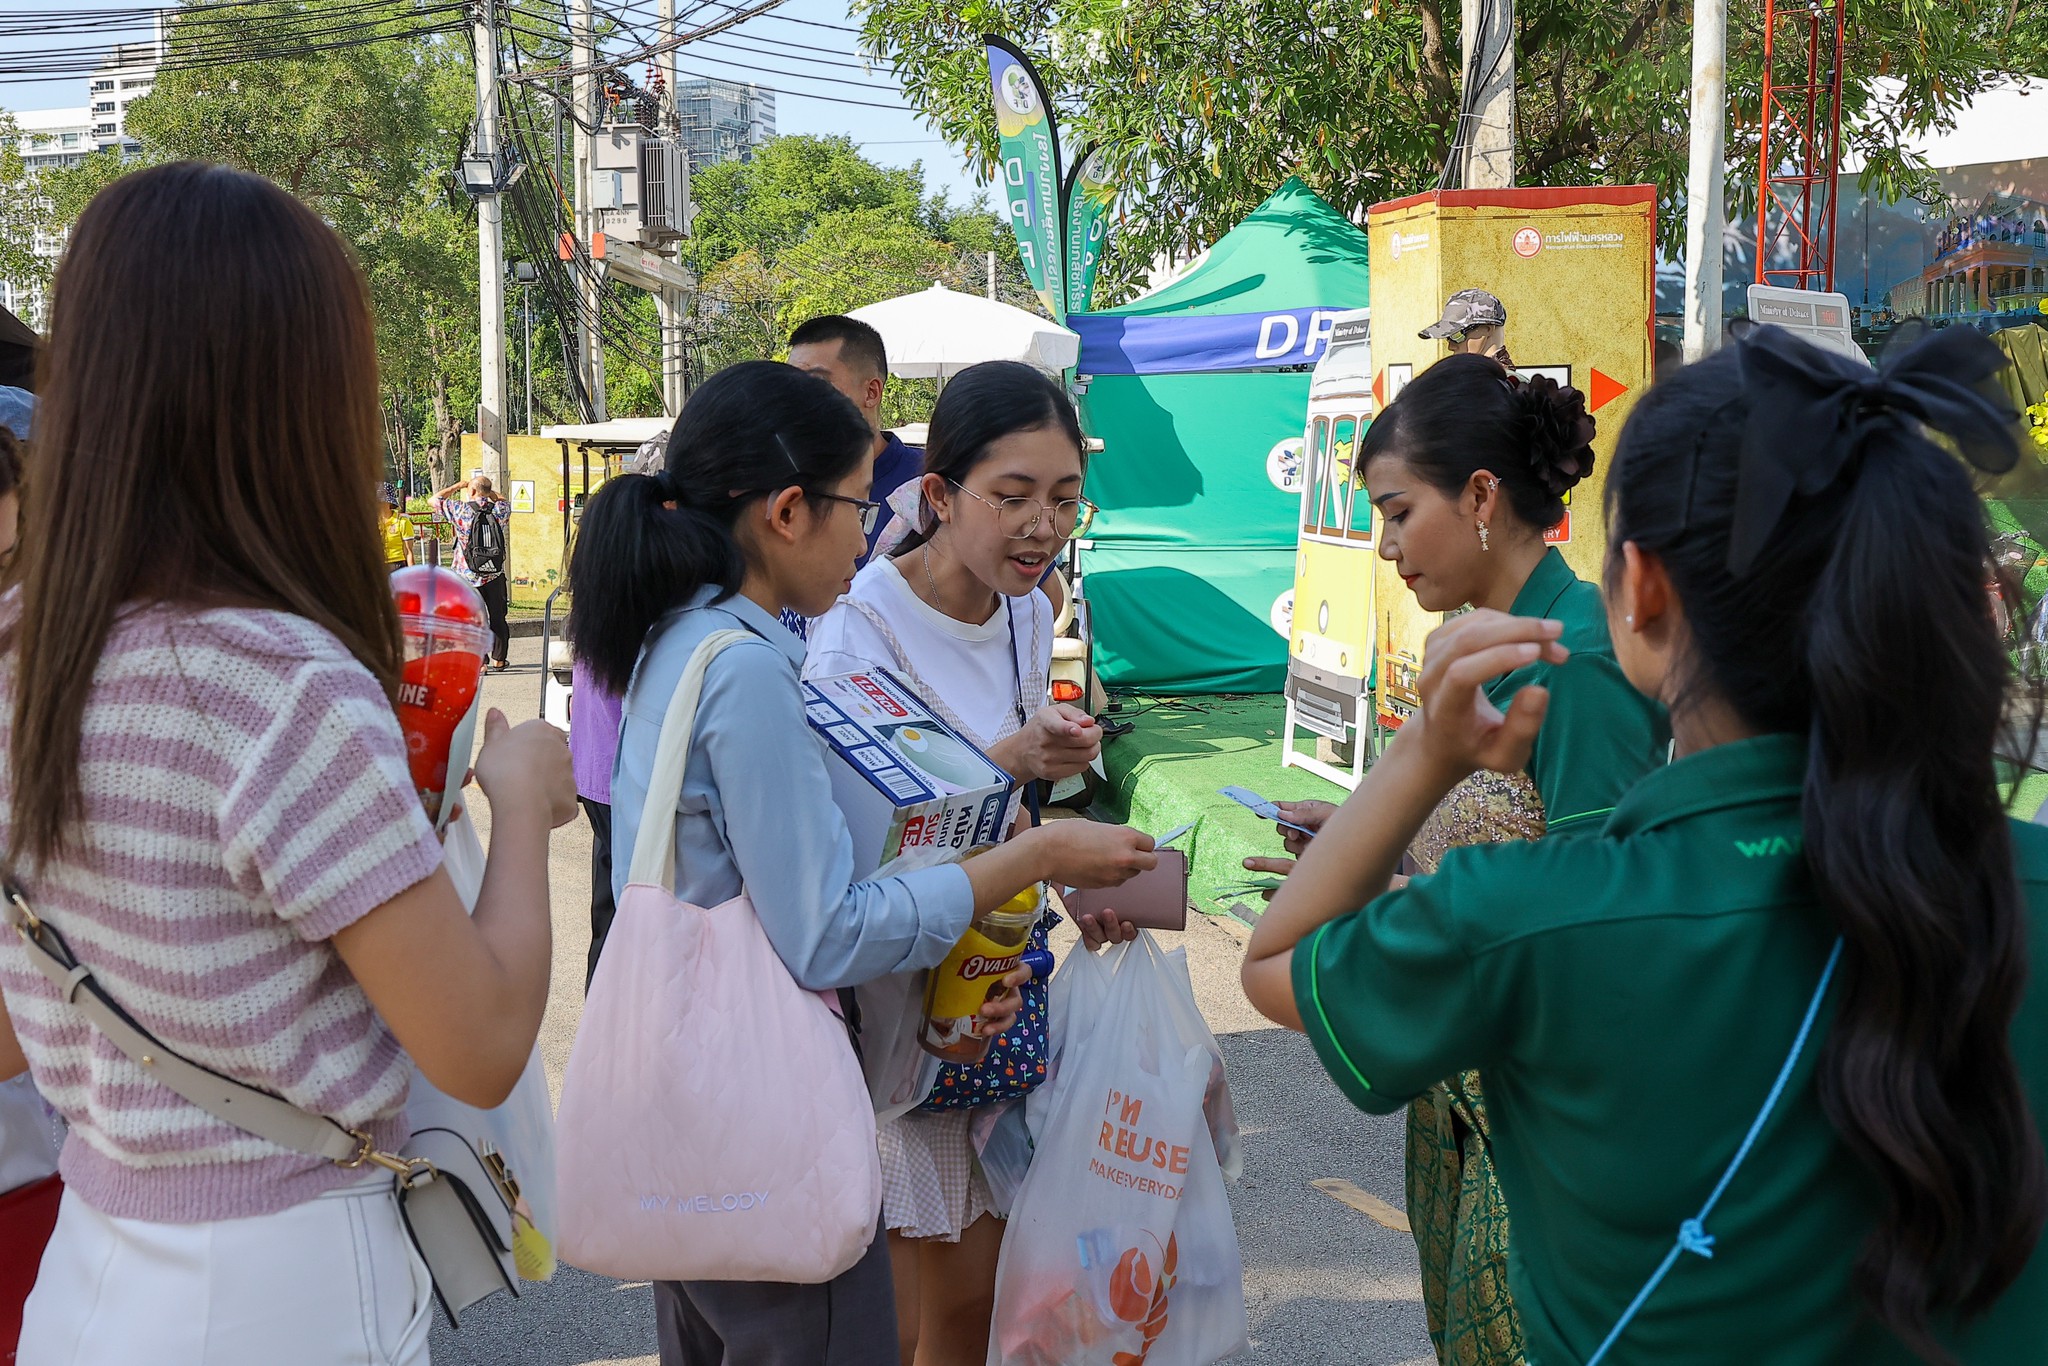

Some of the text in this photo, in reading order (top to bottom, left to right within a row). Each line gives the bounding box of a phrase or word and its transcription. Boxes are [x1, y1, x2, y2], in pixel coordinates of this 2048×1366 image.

[1545, 231, 1624, 243] การไฟฟ้านครหลวง
[1760, 305, 1782, 317] Ministry
[1734, 836, 1800, 858] WA
[1099, 1120, 1190, 1175] REUSE
[640, 1190, 769, 1213] MY MELODY
